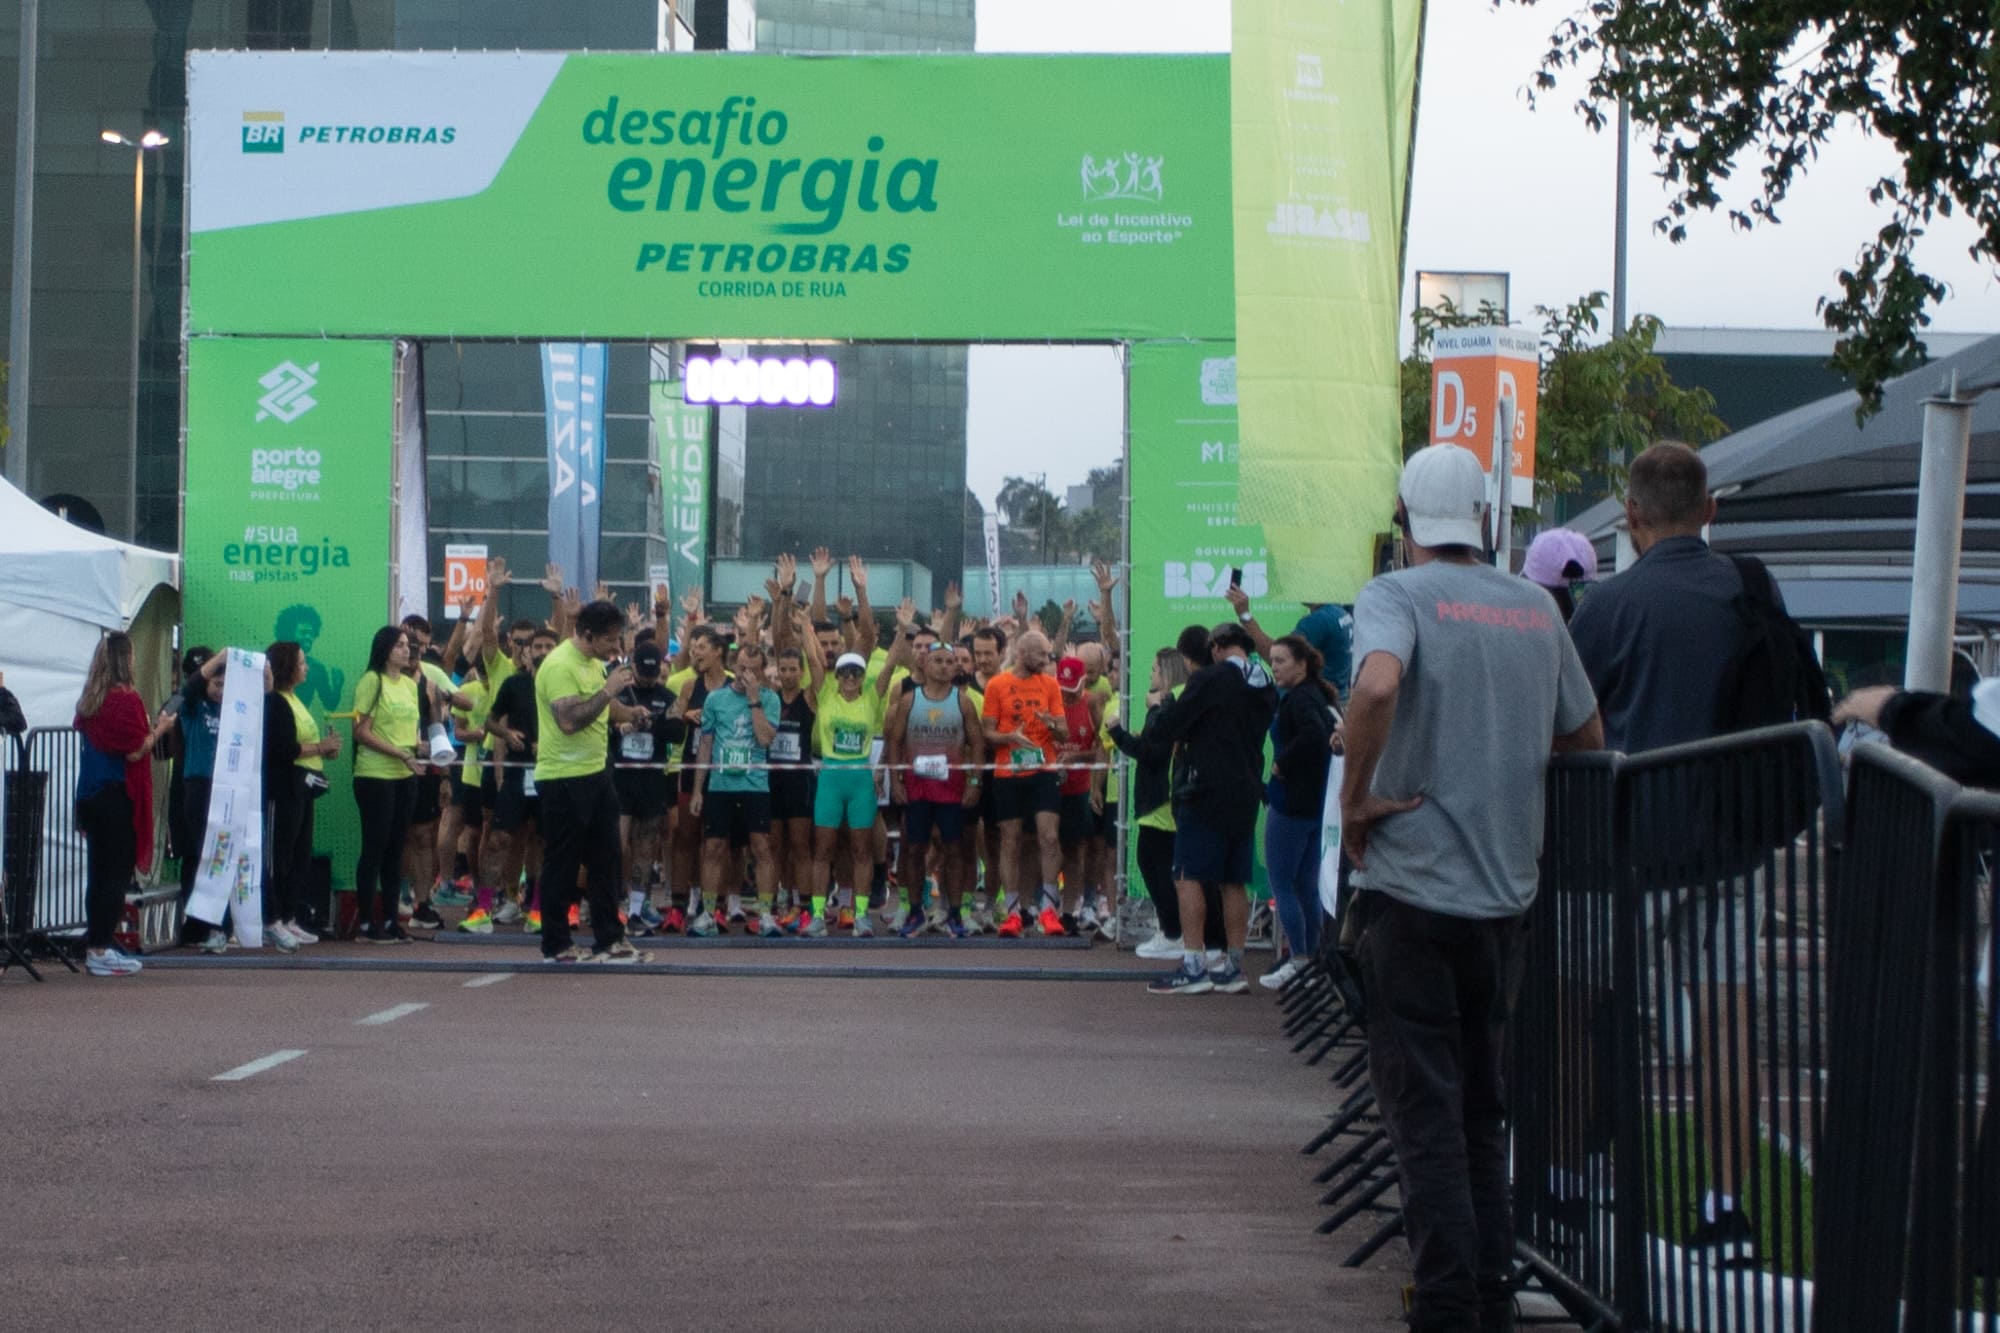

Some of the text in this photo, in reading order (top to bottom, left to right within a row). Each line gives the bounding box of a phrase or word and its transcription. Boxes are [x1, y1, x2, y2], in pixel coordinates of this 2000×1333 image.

[246, 127, 280, 144] BR
[300, 126, 456, 144] PETROBRAS
[583, 95, 789, 160] desafio
[607, 136, 940, 236] energia
[1057, 212, 1193, 227] Lei de Incentivo
[1082, 232, 1102, 244] ao
[636, 243, 912, 274] PETROBRAS
[698, 281, 846, 297] CORRIDA DE RUA
[252, 447, 321, 468] porto
[252, 466, 321, 491] alegre
[251, 490, 320, 501] PREFEITURA
[244, 525, 298, 544] #sua
[224, 537, 351, 575] energia
[1195, 546, 1253, 557] GOVERNO
